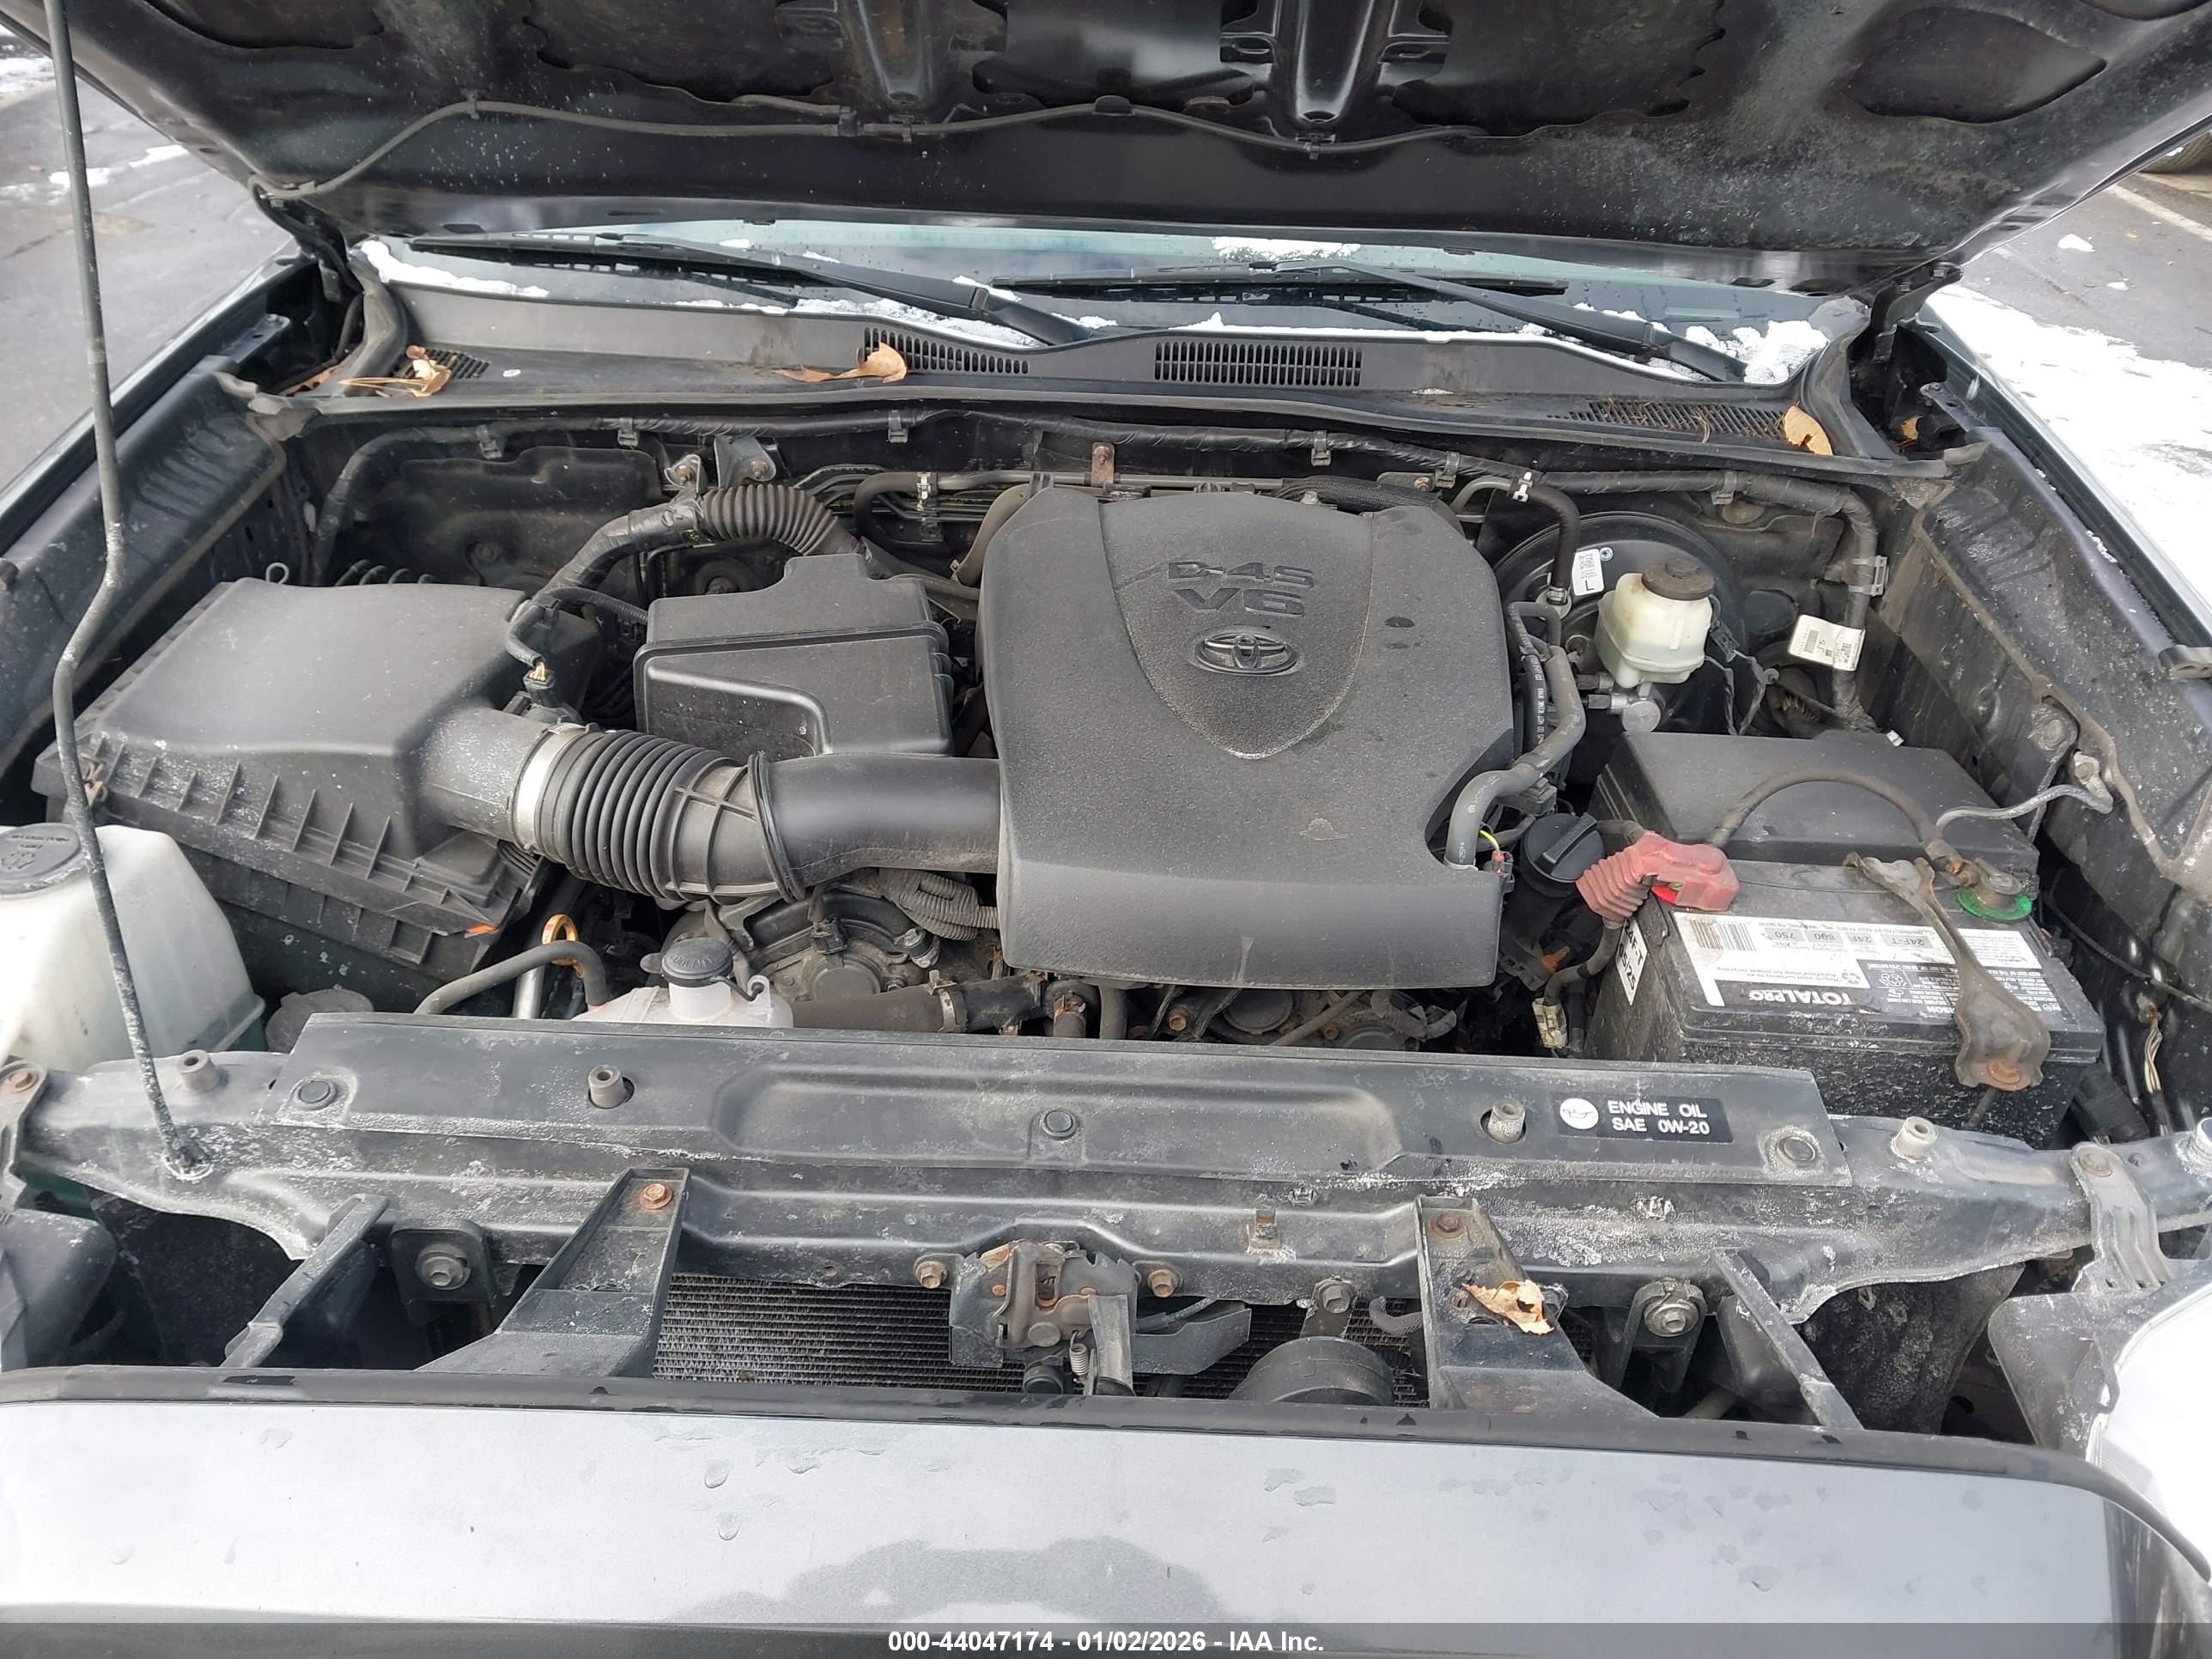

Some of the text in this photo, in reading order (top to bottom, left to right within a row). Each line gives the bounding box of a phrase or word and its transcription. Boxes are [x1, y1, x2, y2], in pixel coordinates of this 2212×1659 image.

[1584, 580, 1595, 591] L
[1173, 587, 1305, 617] V6
[1624, 919, 1644, 967] 24F-T
[1774, 931, 1796, 939] 750
[1892, 937, 1924, 945] 24F-T
[1748, 989, 1854, 1006] TOTALPRO
[1607, 1100, 1707, 1118] ENGINE OIL
[1613, 1117, 1710, 1135] SAE 0W-20
